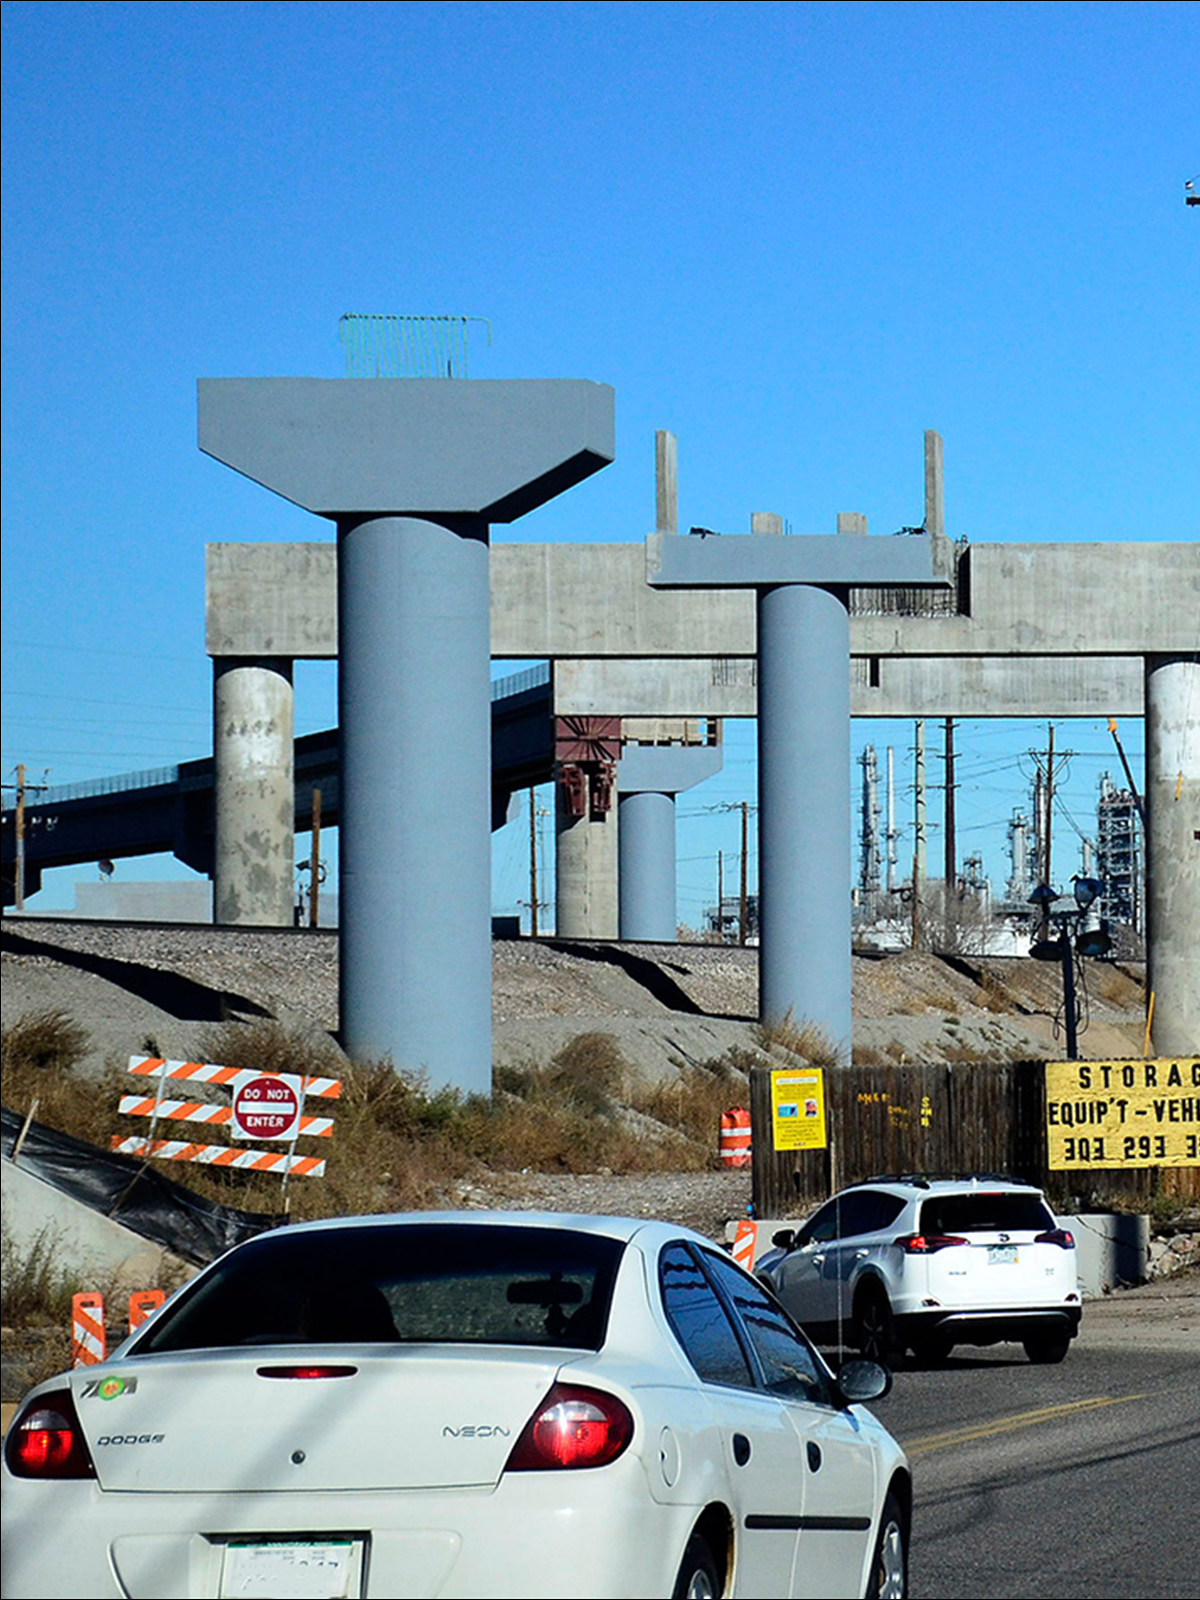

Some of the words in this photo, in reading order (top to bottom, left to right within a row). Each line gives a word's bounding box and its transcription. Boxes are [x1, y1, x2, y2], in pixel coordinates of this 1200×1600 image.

[244, 1088, 261, 1099] DO
[267, 1089, 290, 1100] NOT
[1049, 1097, 1129, 1127] EQUIP'T
[246, 1115, 284, 1127] ENTER
[1064, 1137, 1105, 1162] 303
[1123, 1135, 1165, 1160] 293
[443, 1426, 511, 1437] NEON
[97, 1434, 165, 1446] DODGE
